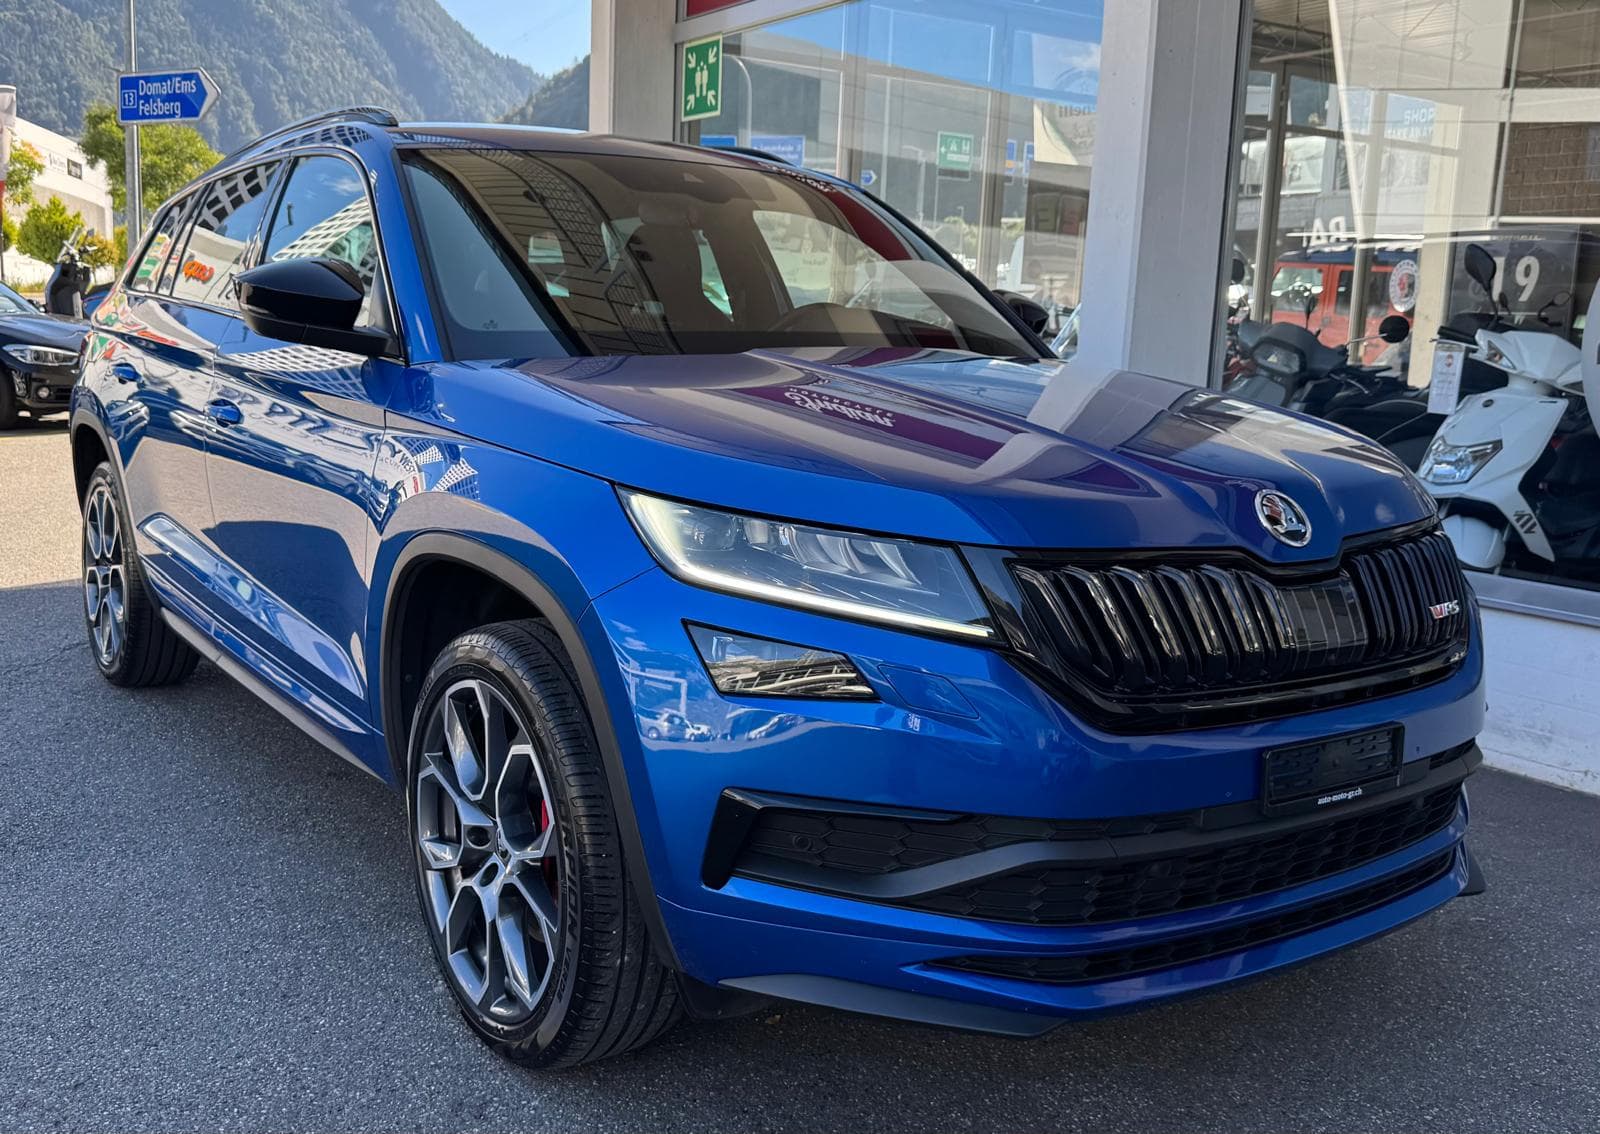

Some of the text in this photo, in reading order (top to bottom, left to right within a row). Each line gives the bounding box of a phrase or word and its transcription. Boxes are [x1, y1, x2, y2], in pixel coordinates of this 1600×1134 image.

[139, 77, 197, 96] Domat/Ems
[124, 93, 134, 106] 13
[139, 98, 181, 118] Felsberg
